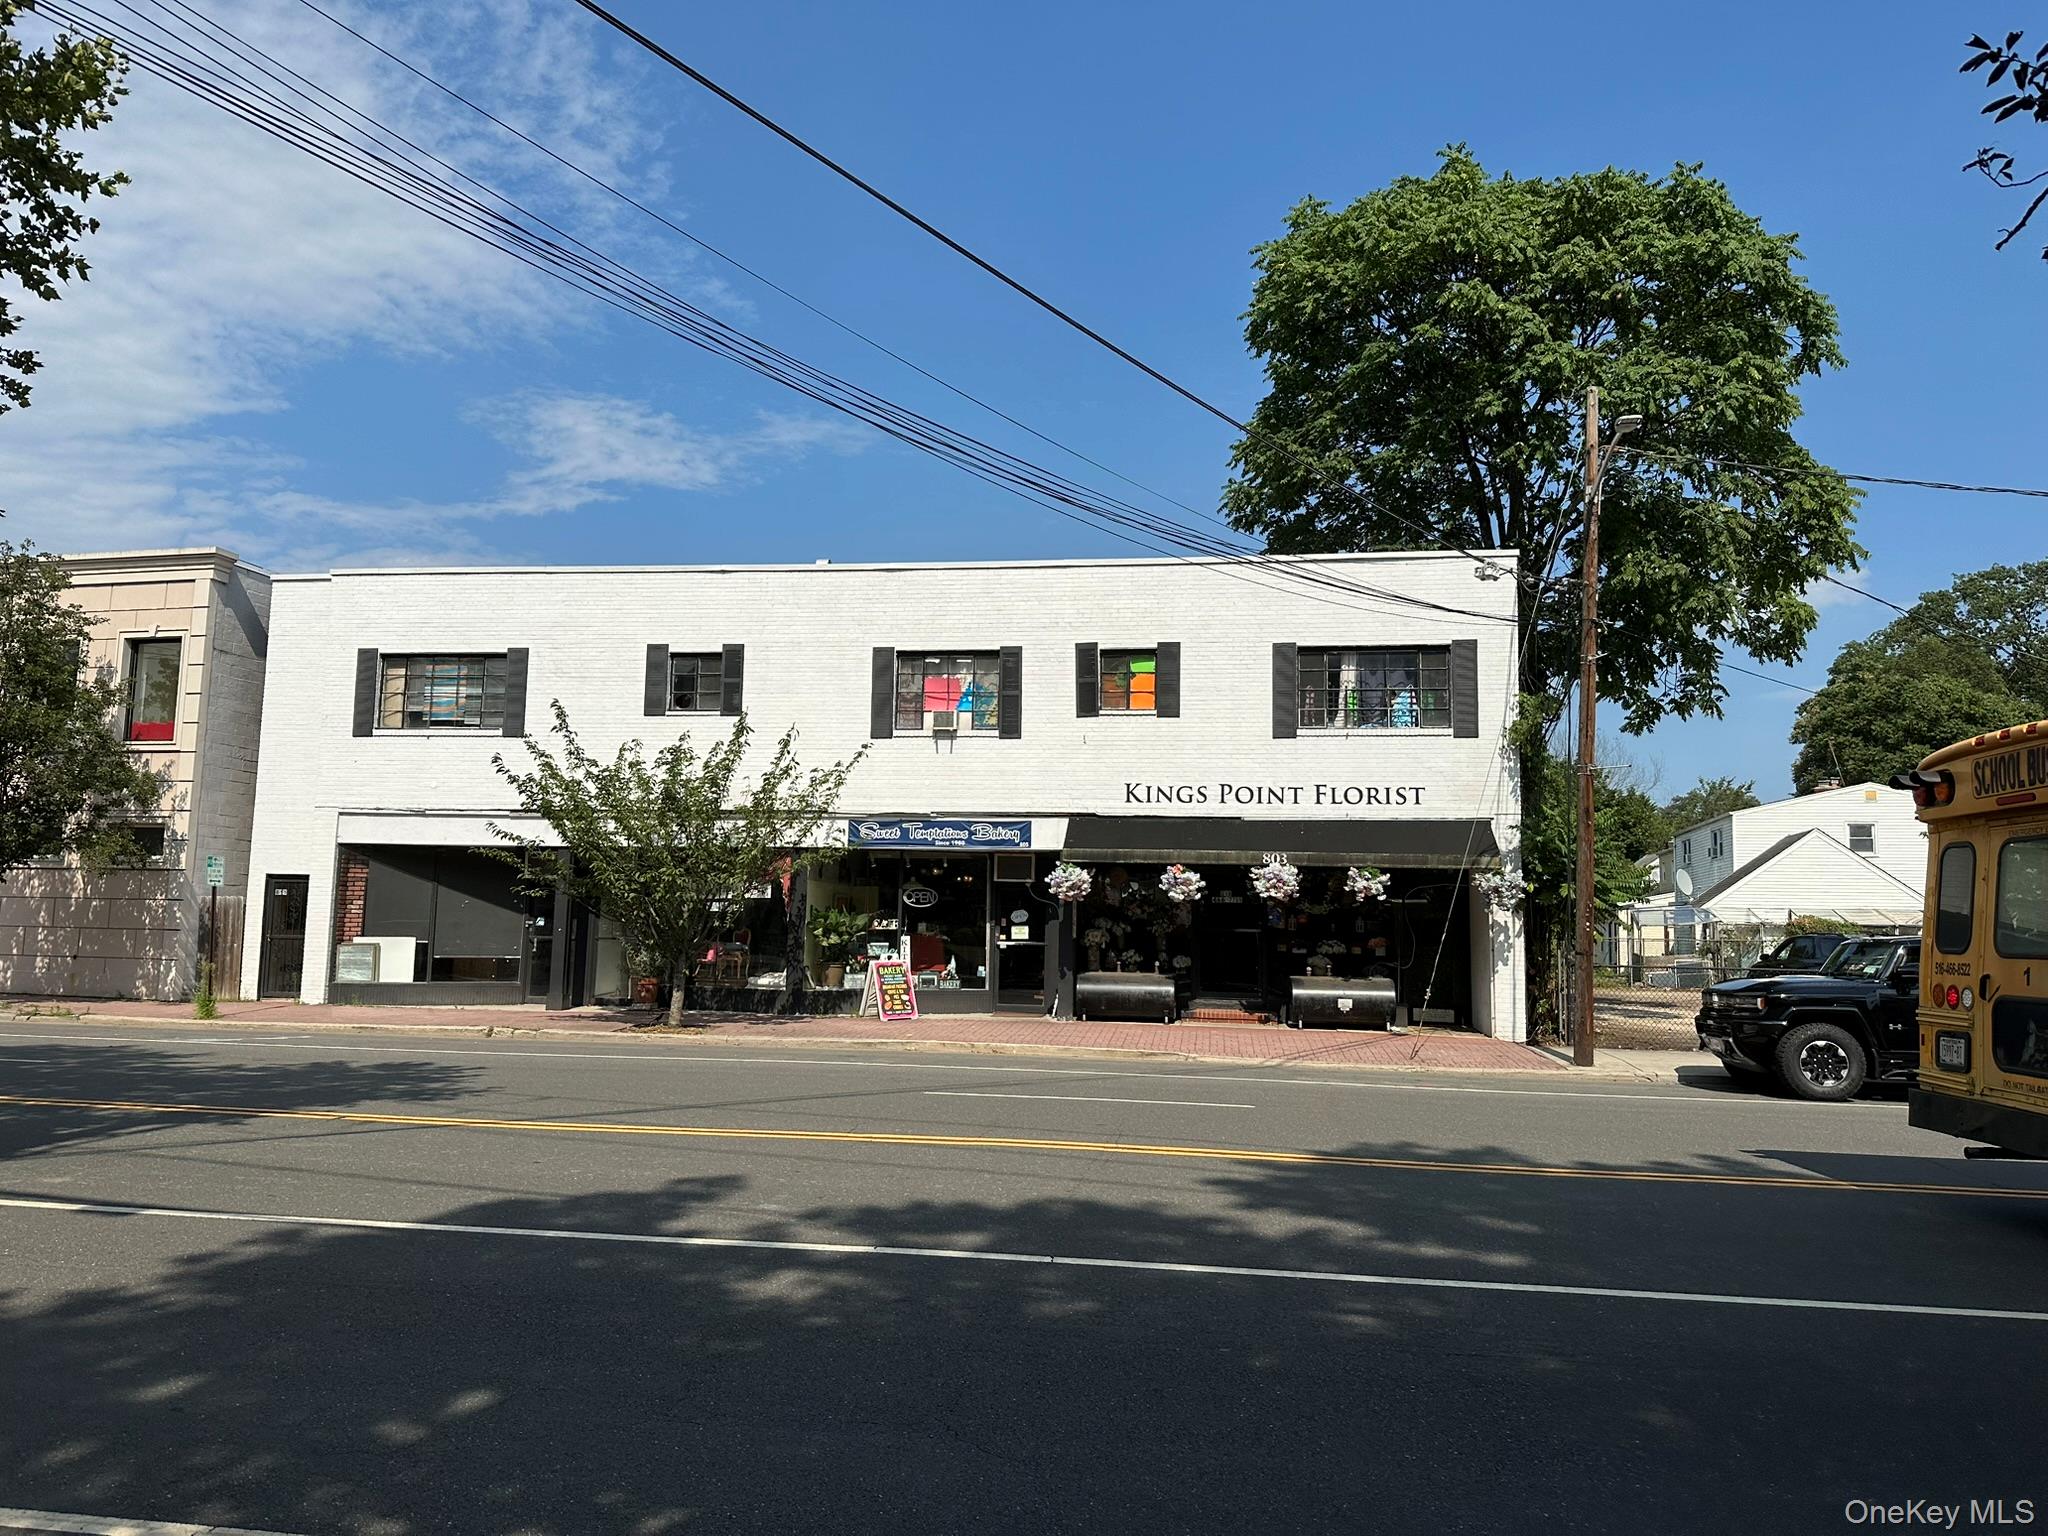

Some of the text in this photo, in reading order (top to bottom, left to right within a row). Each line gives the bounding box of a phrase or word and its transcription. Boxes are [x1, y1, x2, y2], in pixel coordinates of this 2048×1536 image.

[1974, 745, 2048, 796] SCHOOL BU
[1124, 782, 1426, 805] KINGS POINT FLORIST
[859, 821, 1020, 843] Sweet Temptations Bakery
[1262, 852, 1288, 864] 803
[905, 891, 935, 903] OPEN
[879, 966, 907, 975] BAKERY
[2023, 966, 2031, 987] 1
[940, 980, 960, 988] BAKERY
